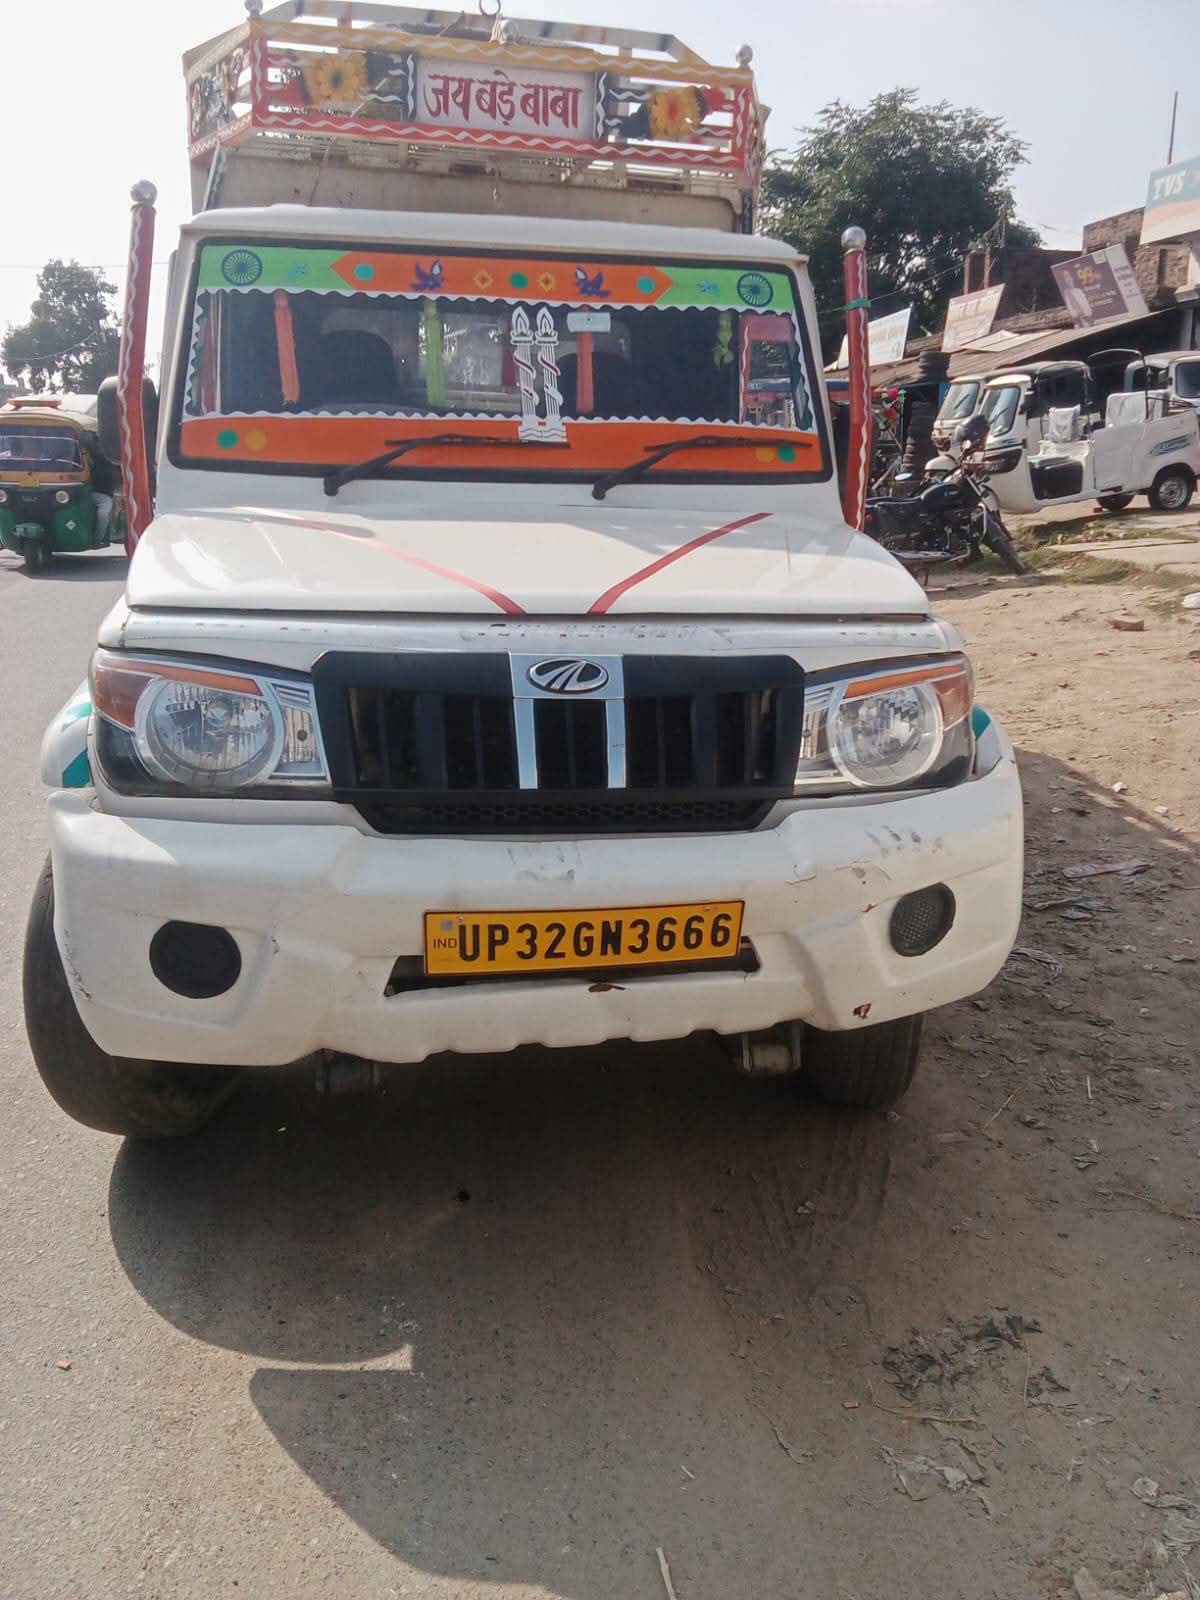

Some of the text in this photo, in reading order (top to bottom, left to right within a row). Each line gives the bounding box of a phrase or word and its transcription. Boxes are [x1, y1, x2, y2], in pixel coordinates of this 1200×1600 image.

[423, 70, 583, 129] जय बड़े बाबा
[1152, 169, 1187, 201] TVS
[433, 913, 732, 962] IND UP32GN3666
